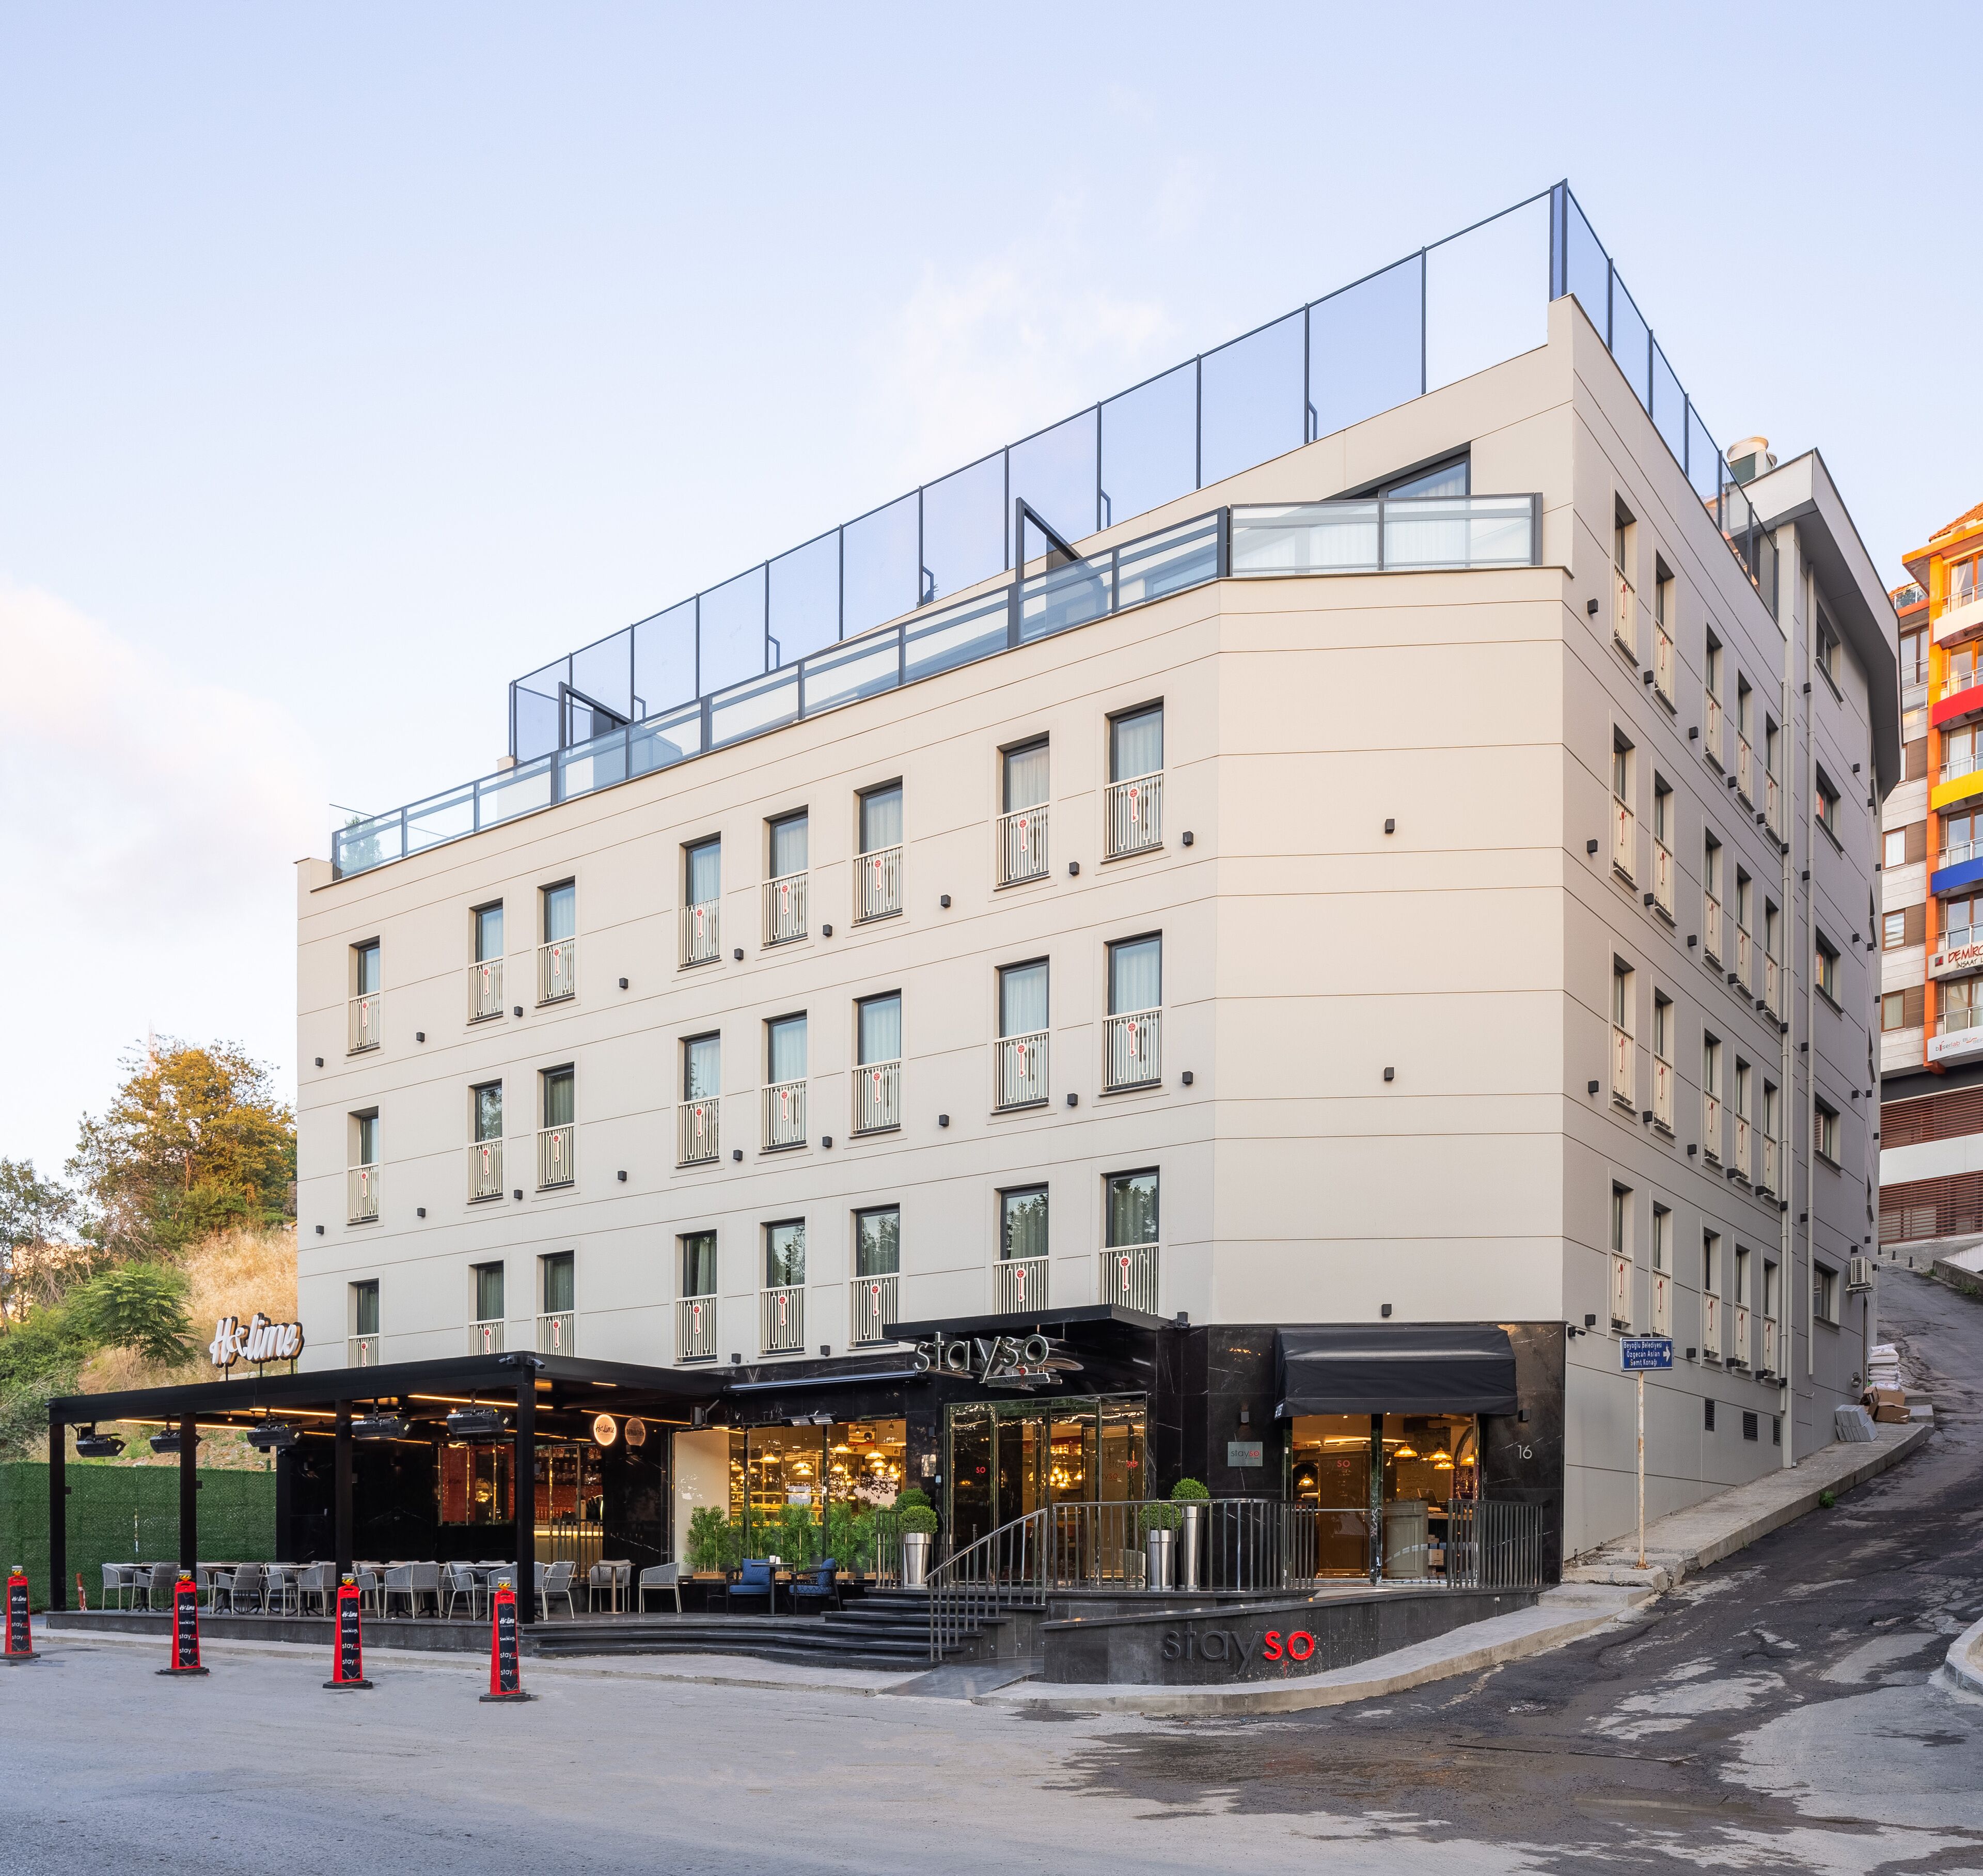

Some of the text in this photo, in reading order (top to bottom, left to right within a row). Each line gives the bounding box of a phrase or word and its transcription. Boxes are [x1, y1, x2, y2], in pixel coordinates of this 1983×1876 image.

[1624, 1341, 1641, 1350] Beyoğlu
[912, 1332, 1049, 1383] stayso
[1626, 1349, 1646, 1359] Özgecan
[1643, 1358, 1657, 1367] Konağı
[1231, 1449, 1260, 1459] stayso
[1517, 1445, 1532, 1459] 16
[1163, 1622, 1315, 1675] stayso
